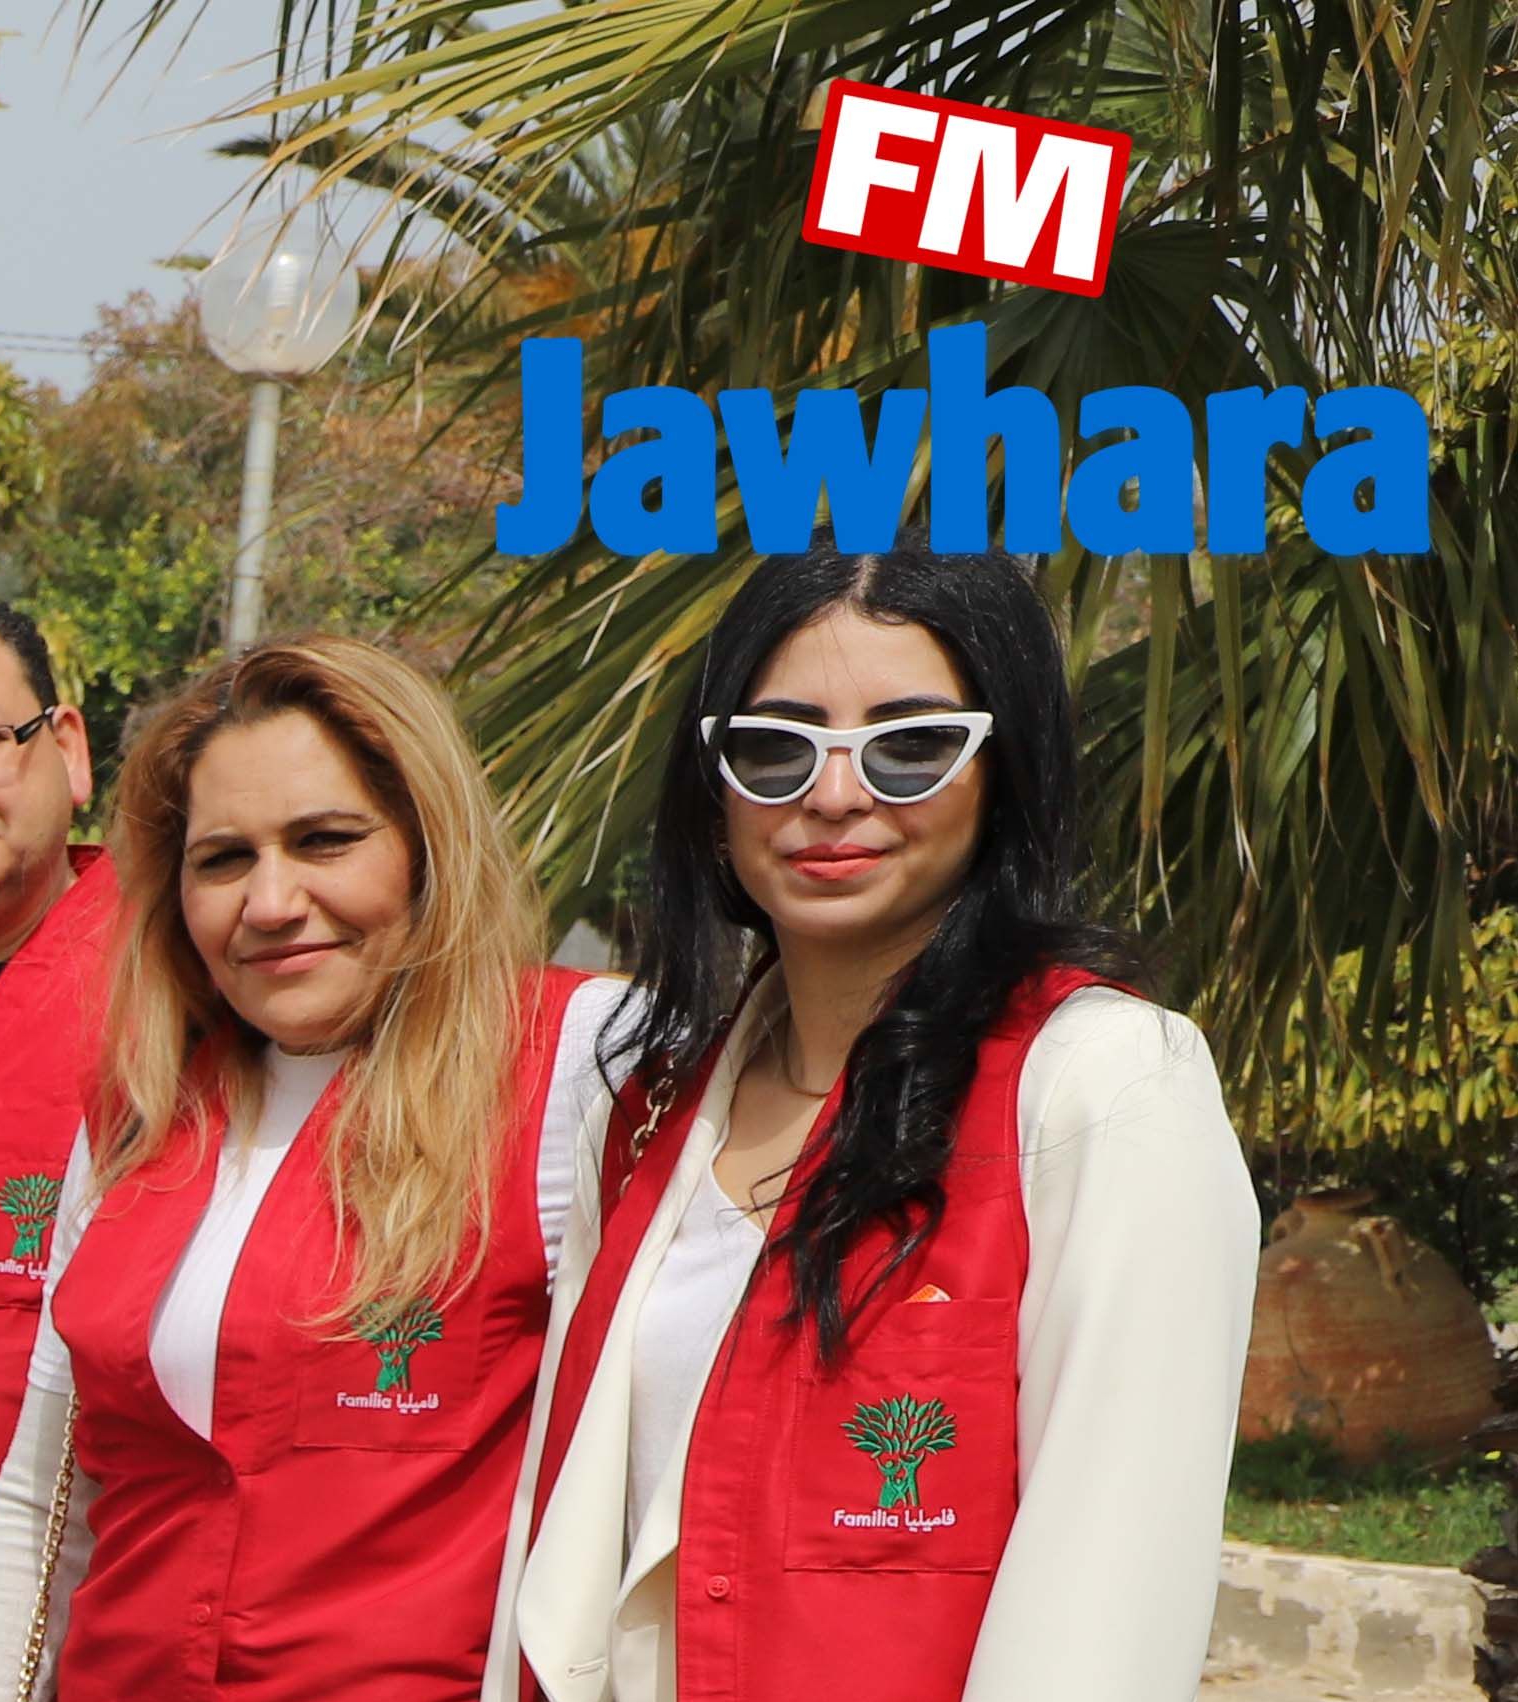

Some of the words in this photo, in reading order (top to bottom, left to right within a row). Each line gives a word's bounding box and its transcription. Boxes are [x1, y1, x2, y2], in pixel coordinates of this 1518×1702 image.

[337, 1392, 392, 1408] Familia
[396, 1393, 439, 1414] فاميليا
[834, 1509, 899, 1527] Familia
[905, 1508, 956, 1532] فاميليا
